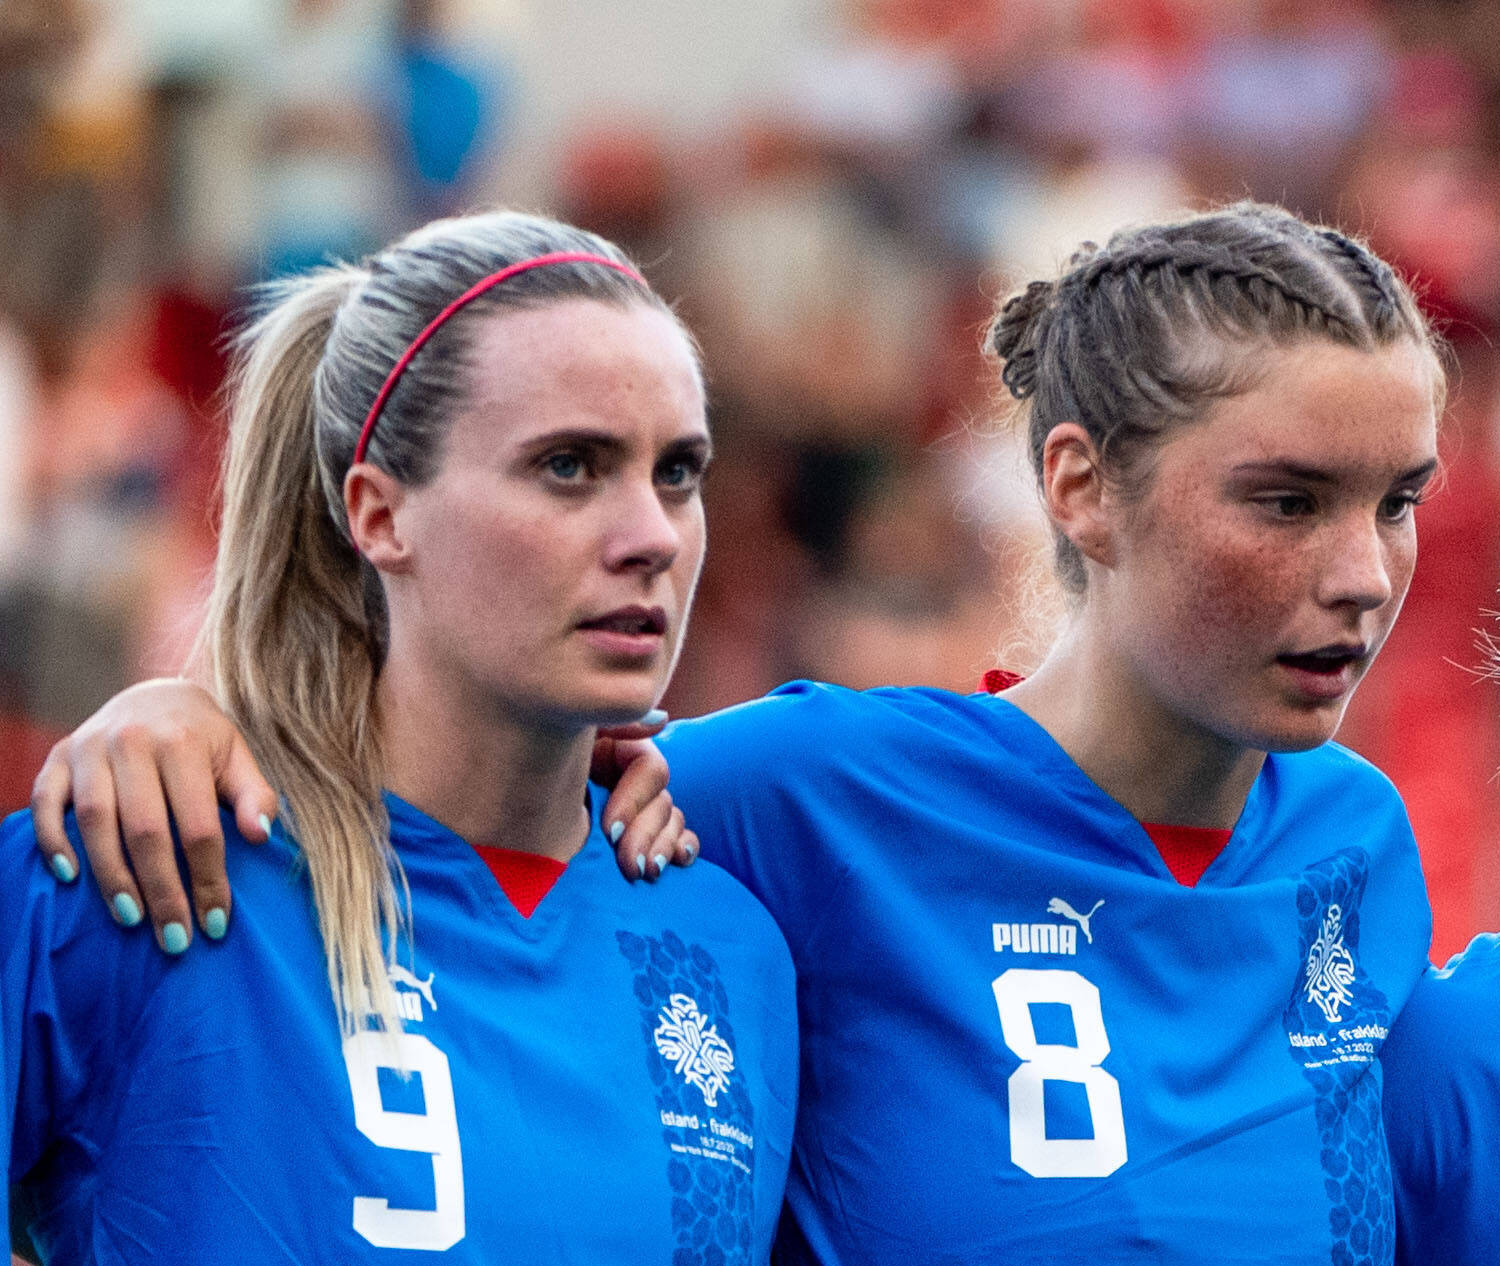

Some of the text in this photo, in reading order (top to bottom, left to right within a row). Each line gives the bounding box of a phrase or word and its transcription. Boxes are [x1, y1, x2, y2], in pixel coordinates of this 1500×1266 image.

[992, 922, 1077, 955] PUMA
[341, 1031, 466, 1252] 9
[992, 968, 1128, 1178] 8
